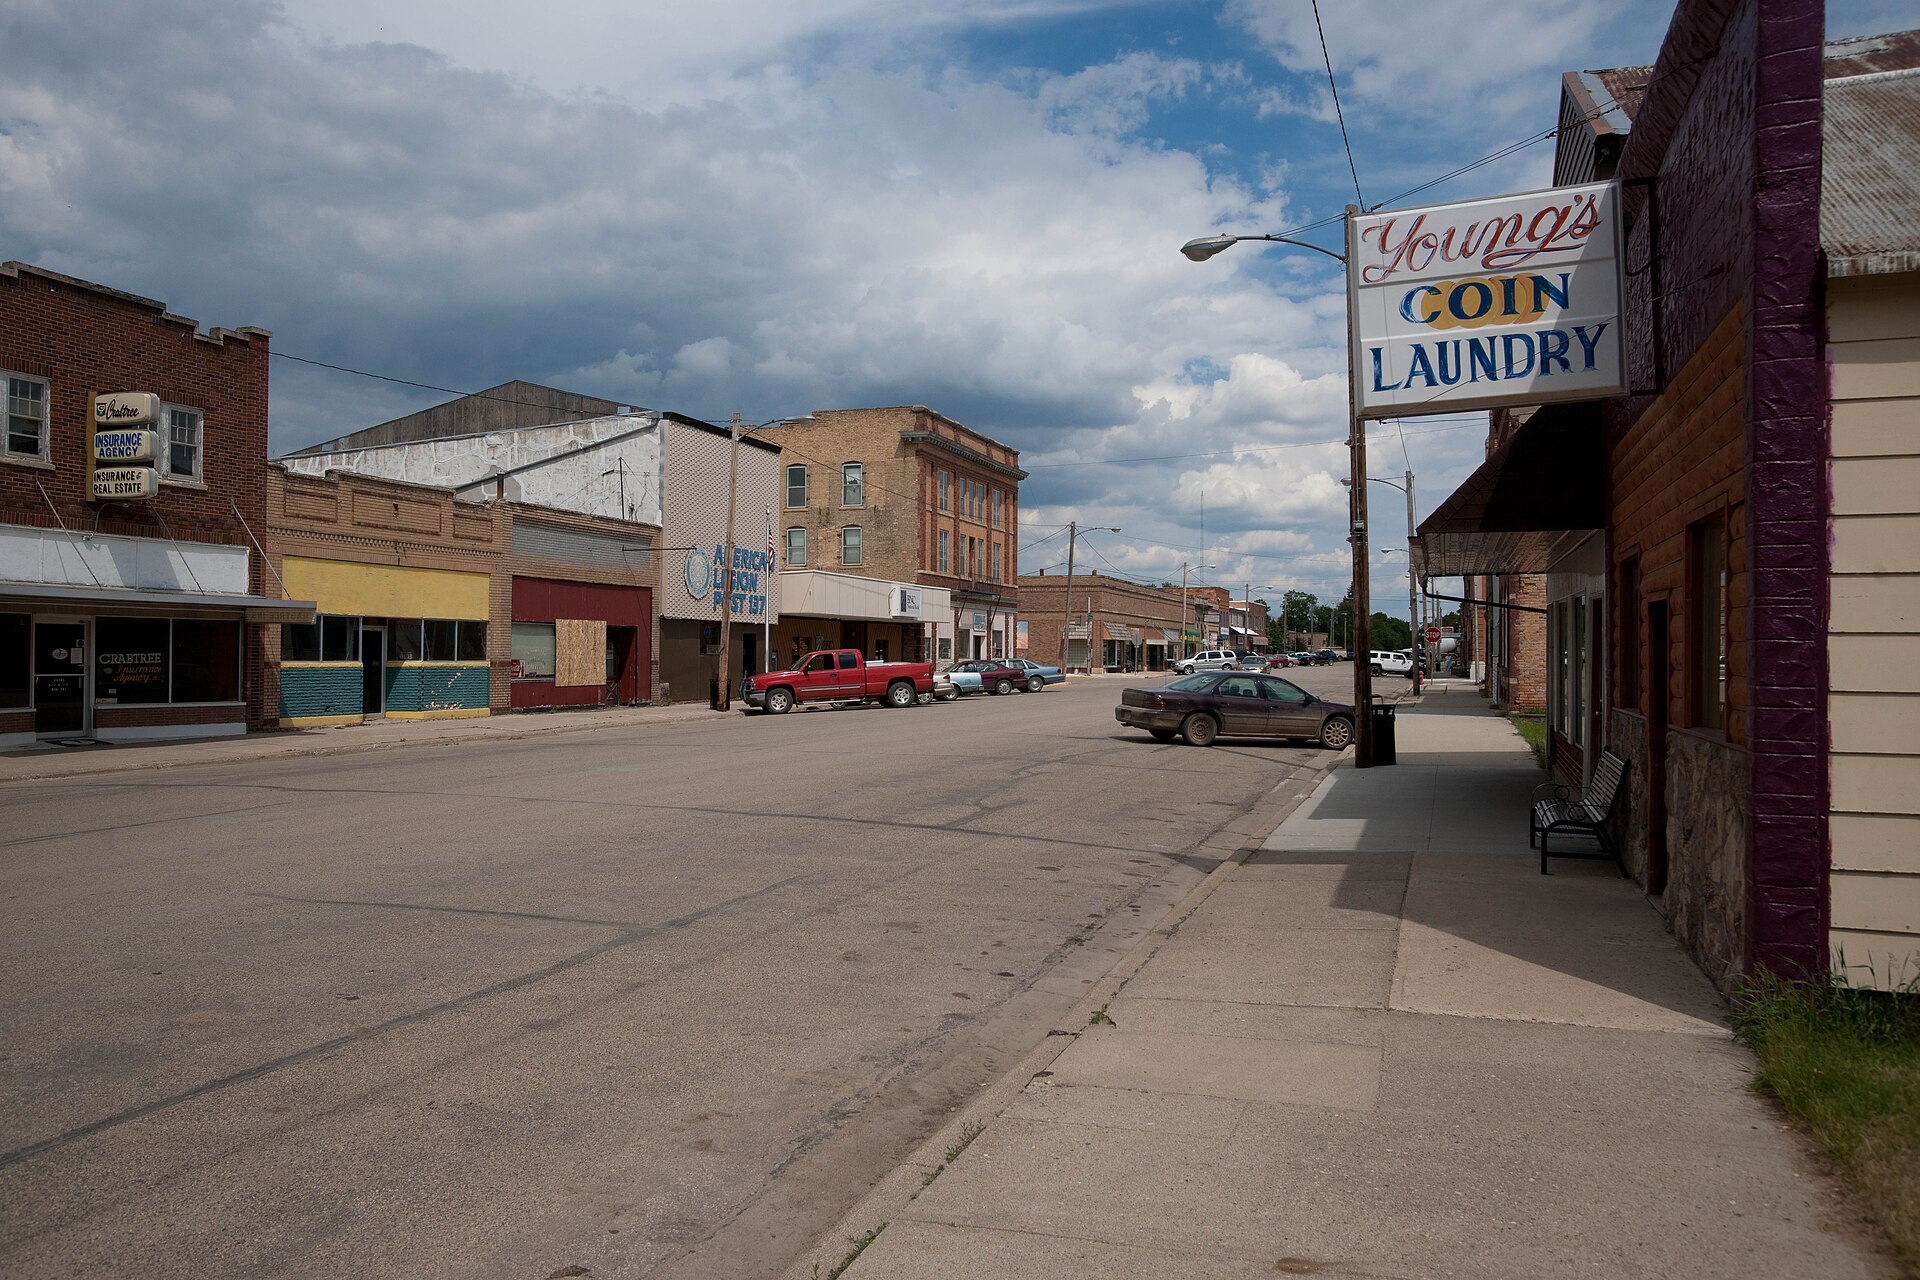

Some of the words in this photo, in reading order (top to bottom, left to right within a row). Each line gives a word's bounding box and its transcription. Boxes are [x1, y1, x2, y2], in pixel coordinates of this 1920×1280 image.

[1361, 194, 1602, 283] Young's
[1399, 272, 1572, 325] COIN
[1369, 322, 1610, 393] LAUNDRY
[106, 399, 140, 420] Crabtree
[95, 433, 142, 448] INSURANCE
[99, 447, 138, 458] AGENCY
[94, 470, 135, 482] INSURANCE
[94, 483, 112, 494] REAL
[114, 482, 142, 494] ESTATE
[714, 544, 776, 572] AERICA
[714, 591, 746, 613] PST
[749, 595, 766, 616] 137
[99, 652, 161, 664] CRABTREE
[115, 665, 161, 673] Insurance
